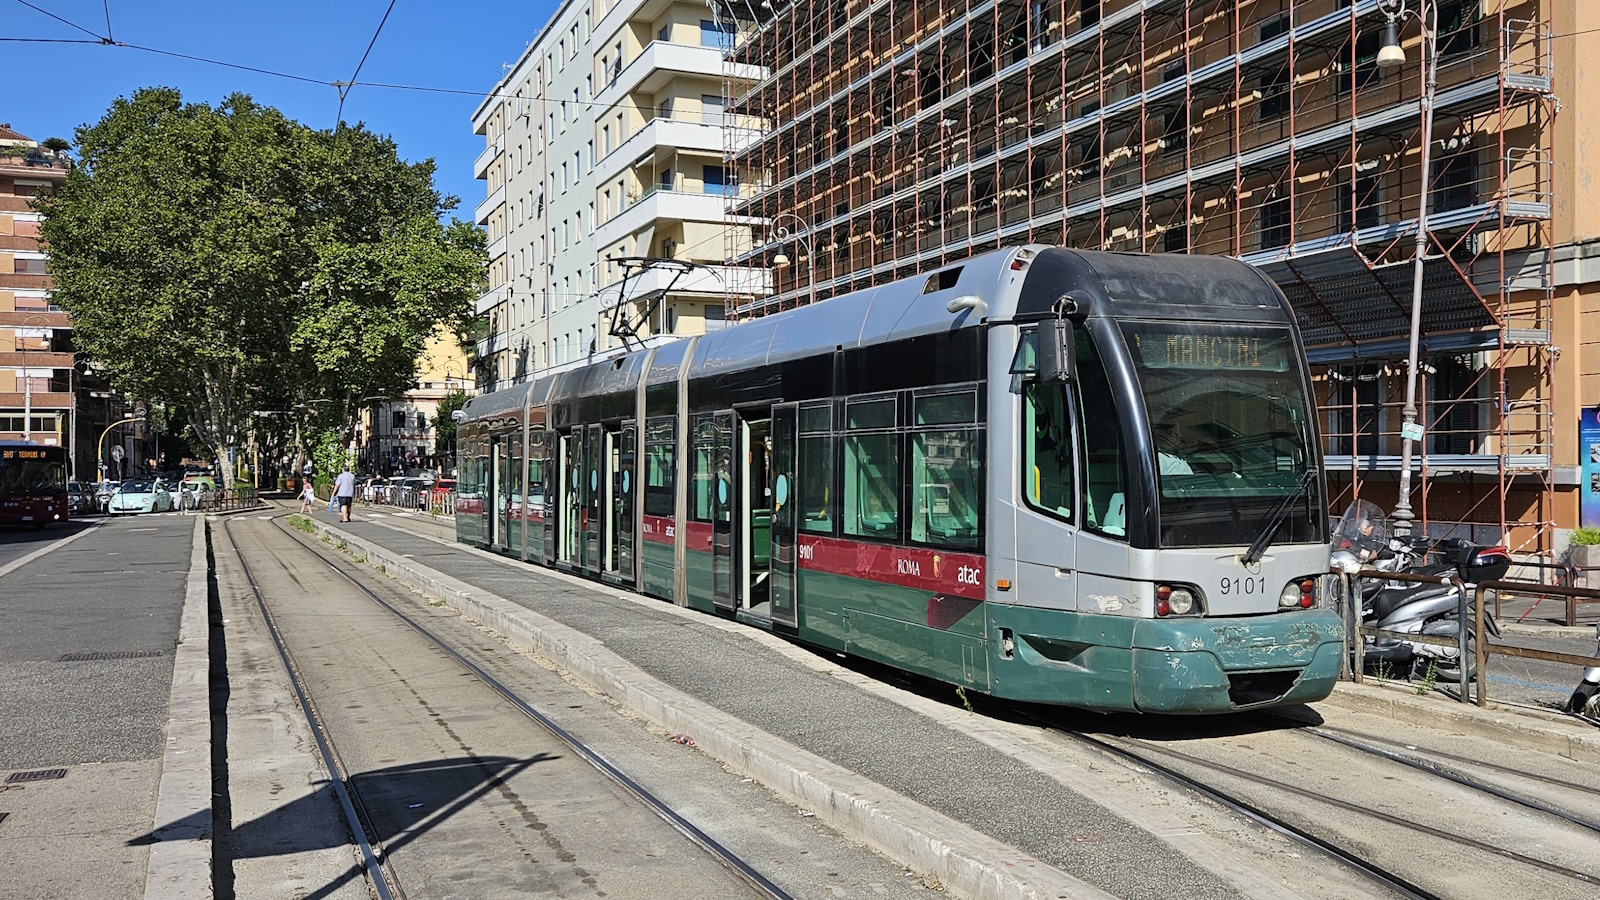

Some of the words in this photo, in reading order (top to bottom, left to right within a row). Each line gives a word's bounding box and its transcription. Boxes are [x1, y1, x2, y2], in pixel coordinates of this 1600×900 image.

[1166, 333, 1261, 367] MANCINI
[799, 544, 813, 559] 9101
[897, 558, 921, 576] ROMA
[957, 564, 980, 585] atac
[1220, 576, 1265, 595] 9101
